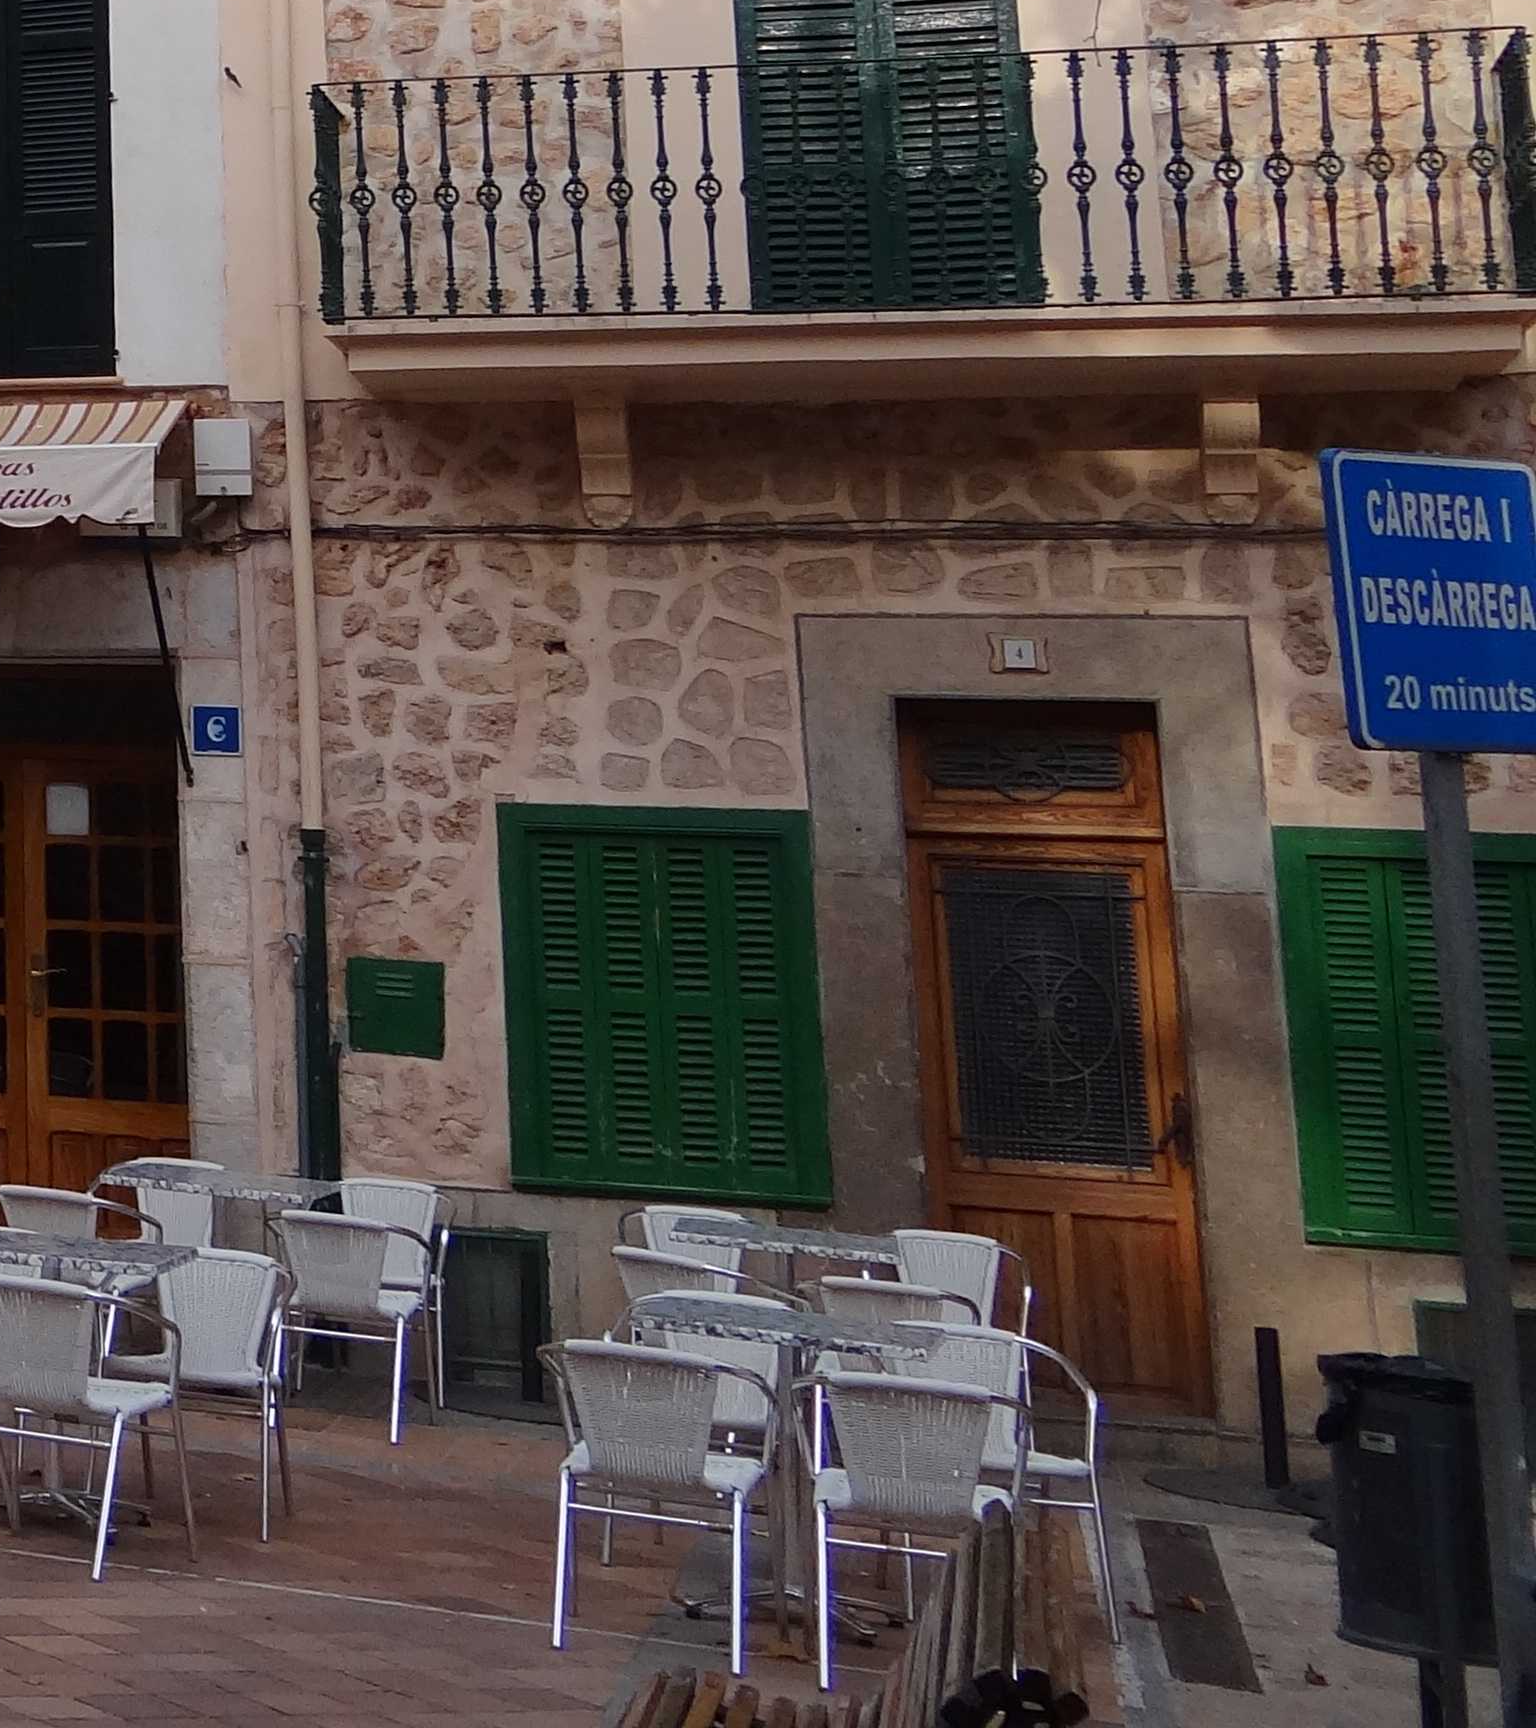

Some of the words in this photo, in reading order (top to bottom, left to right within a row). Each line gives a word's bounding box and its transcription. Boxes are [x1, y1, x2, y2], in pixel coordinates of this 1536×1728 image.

[1366, 479, 1493, 542] CÀRREGA
[1500, 498, 1512, 543] I
[1360, 569, 1536, 630] DESCÀRREGA
[1384, 675, 1421, 710] 20
[1431, 676, 1536, 713] minuts
